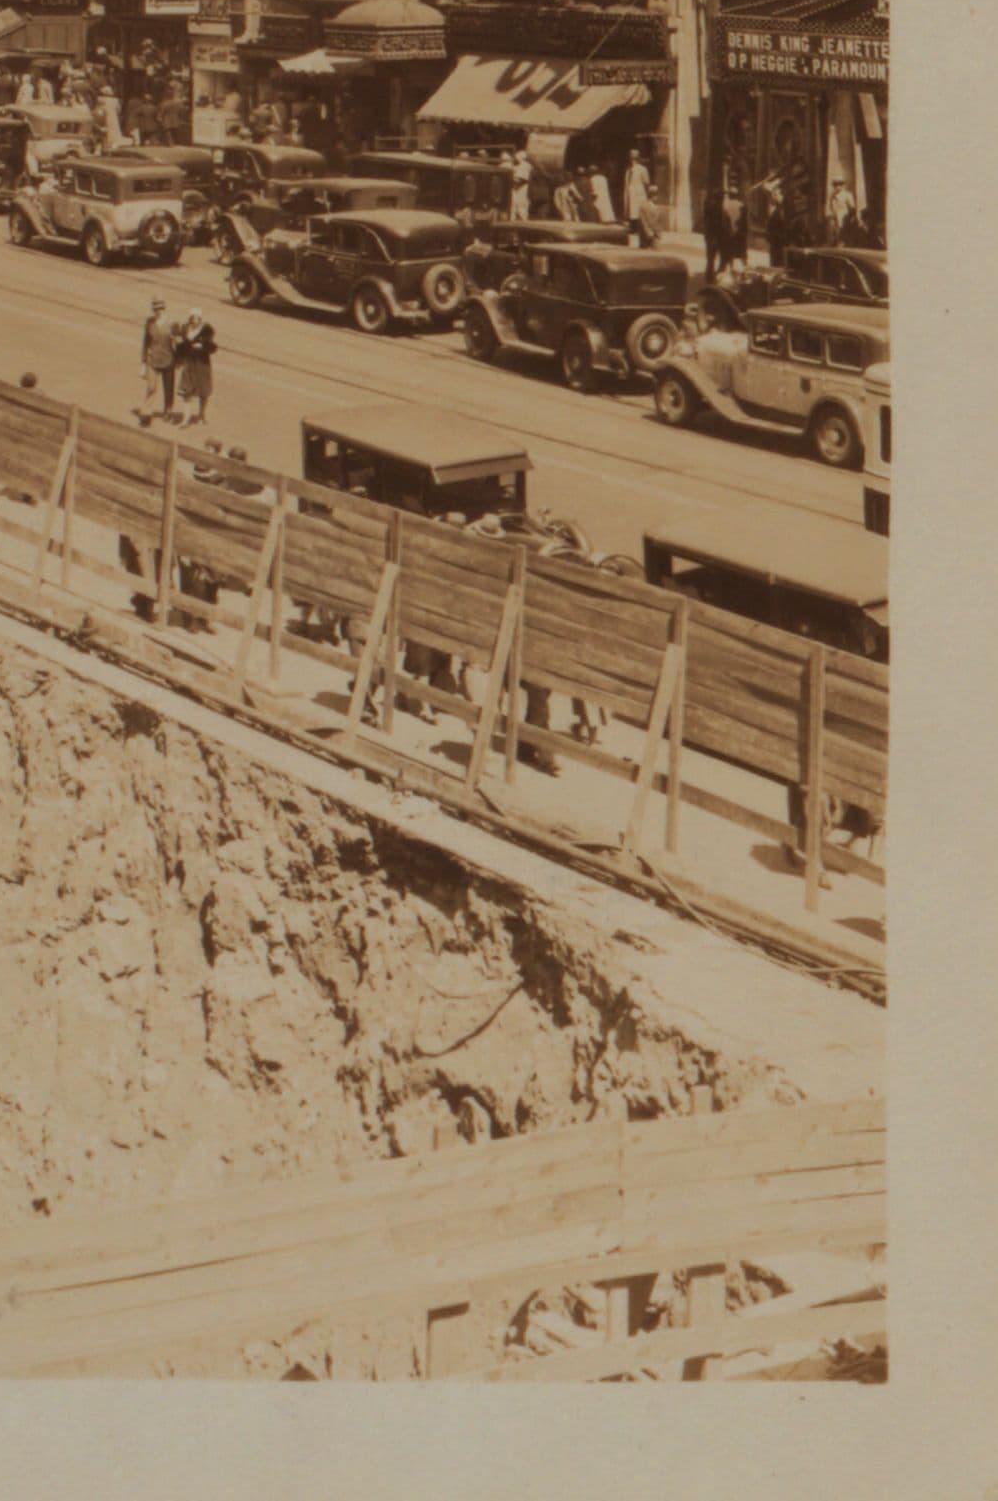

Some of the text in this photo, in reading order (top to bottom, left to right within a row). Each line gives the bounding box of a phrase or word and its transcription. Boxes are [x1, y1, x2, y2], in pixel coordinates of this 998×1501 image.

[727, 31, 888, 59] DENNIS KING JEANETTE
[750, 53, 799, 74] HEGGIE
[811, 56, 887, 80] PARAMOUN
